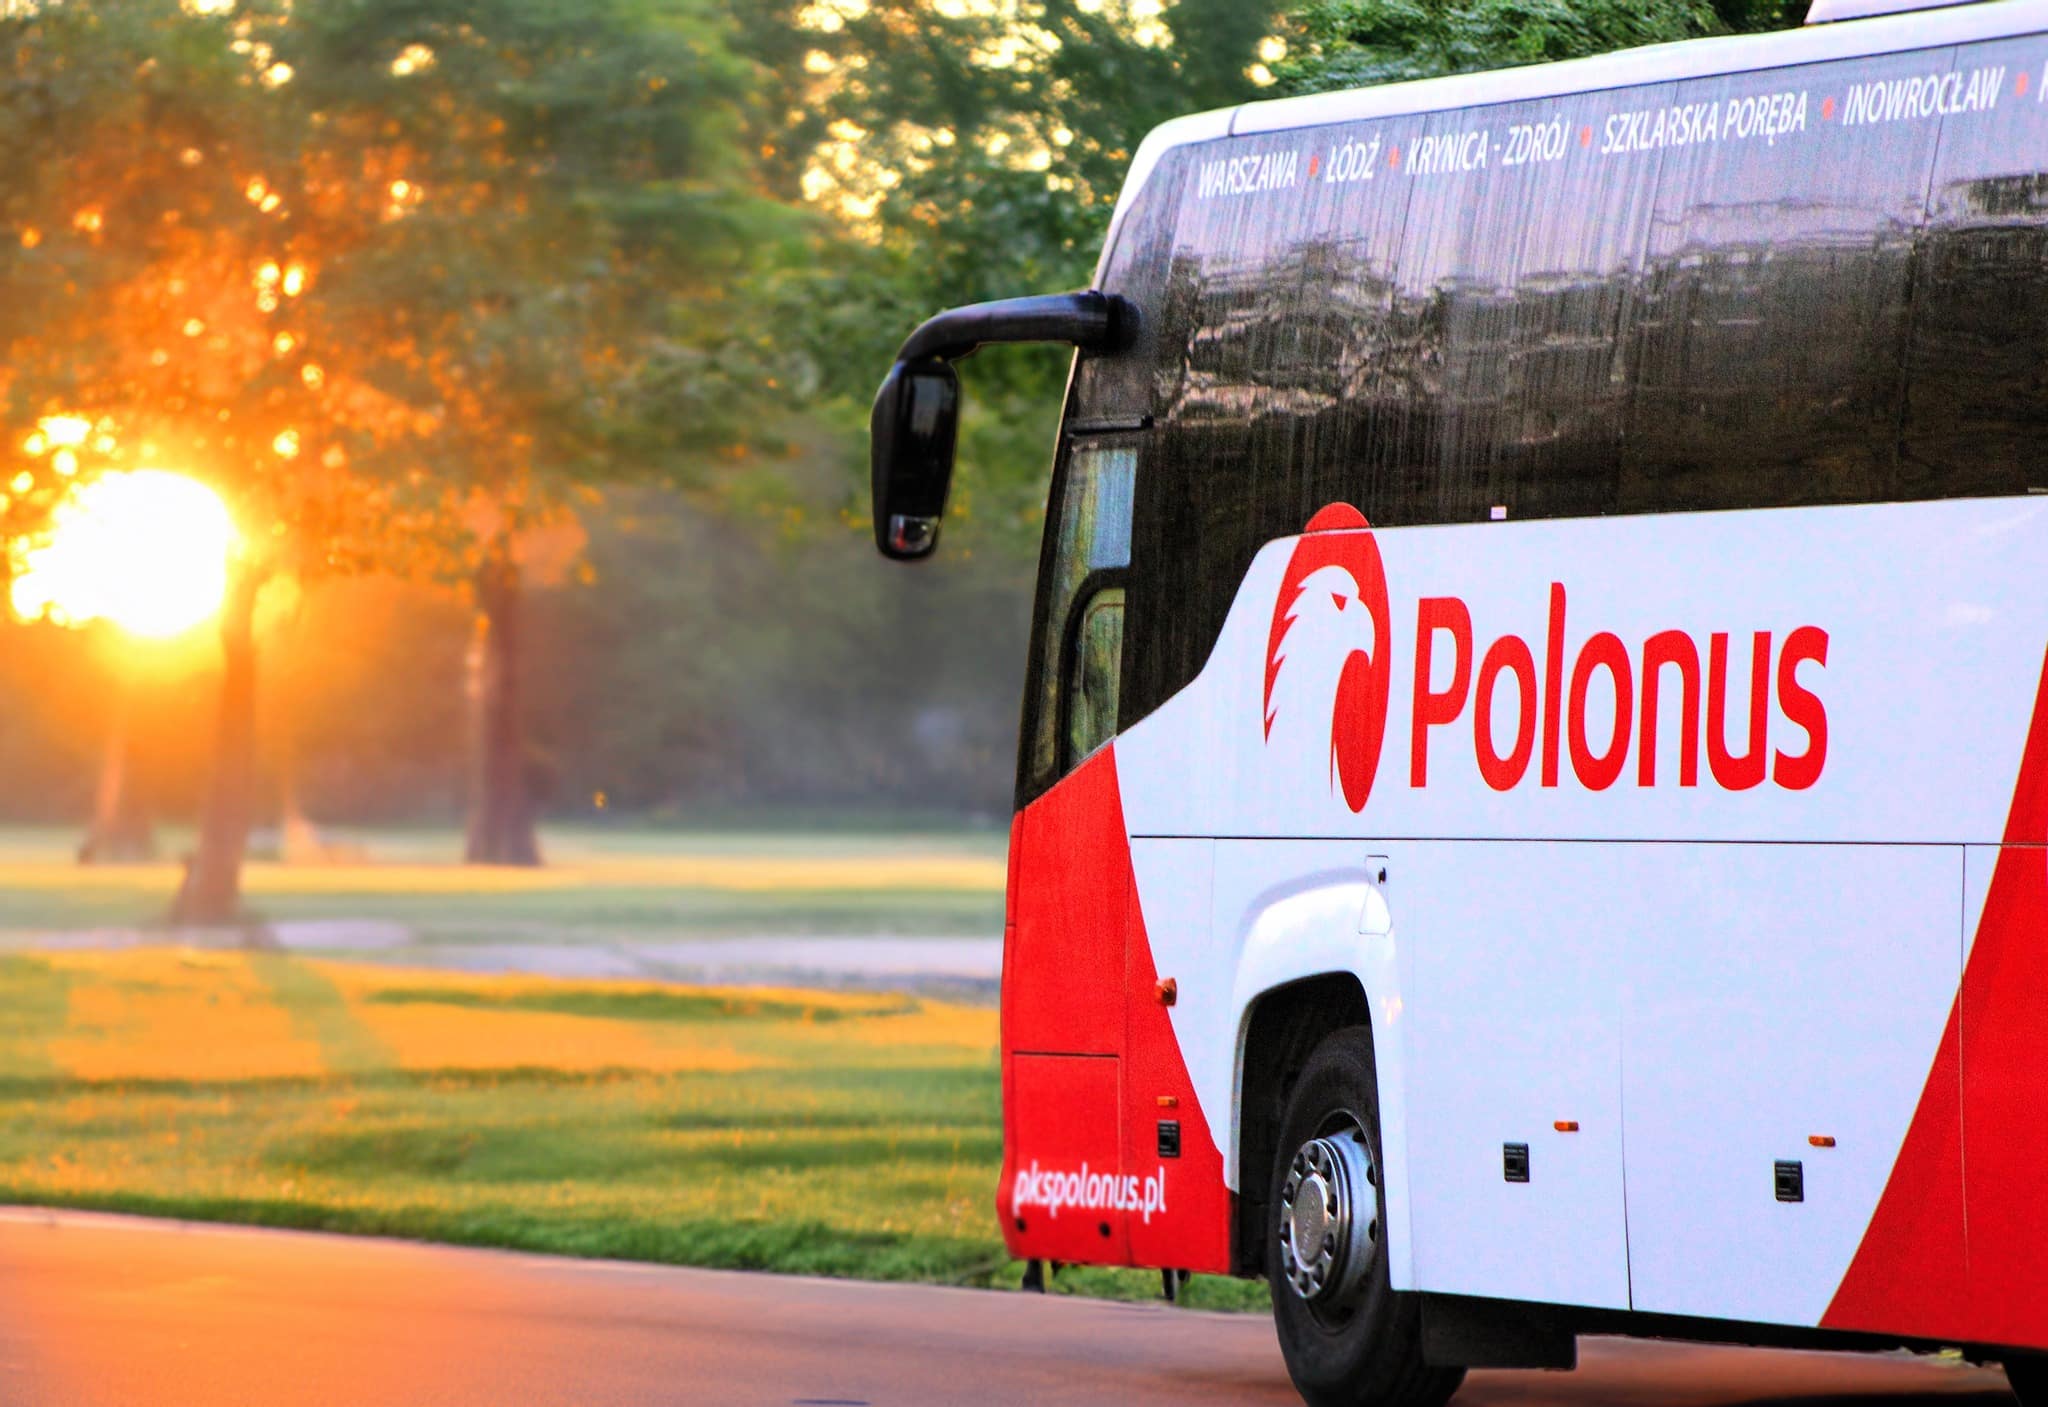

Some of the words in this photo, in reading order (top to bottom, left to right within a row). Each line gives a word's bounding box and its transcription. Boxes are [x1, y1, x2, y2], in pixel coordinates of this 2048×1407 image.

[1198, 150, 1298, 199] WARSZAWA
[1325, 132, 1381, 184] ŁÓDŹ
[1601, 101, 1719, 154] SZKLARSKA
[1723, 91, 1808, 146] PORĘBA
[1842, 66, 2006, 126] INOWROCŁAW
[1410, 582, 1829, 791] Polonus
[1013, 1159, 1166, 1224] pkspolonus.pl
